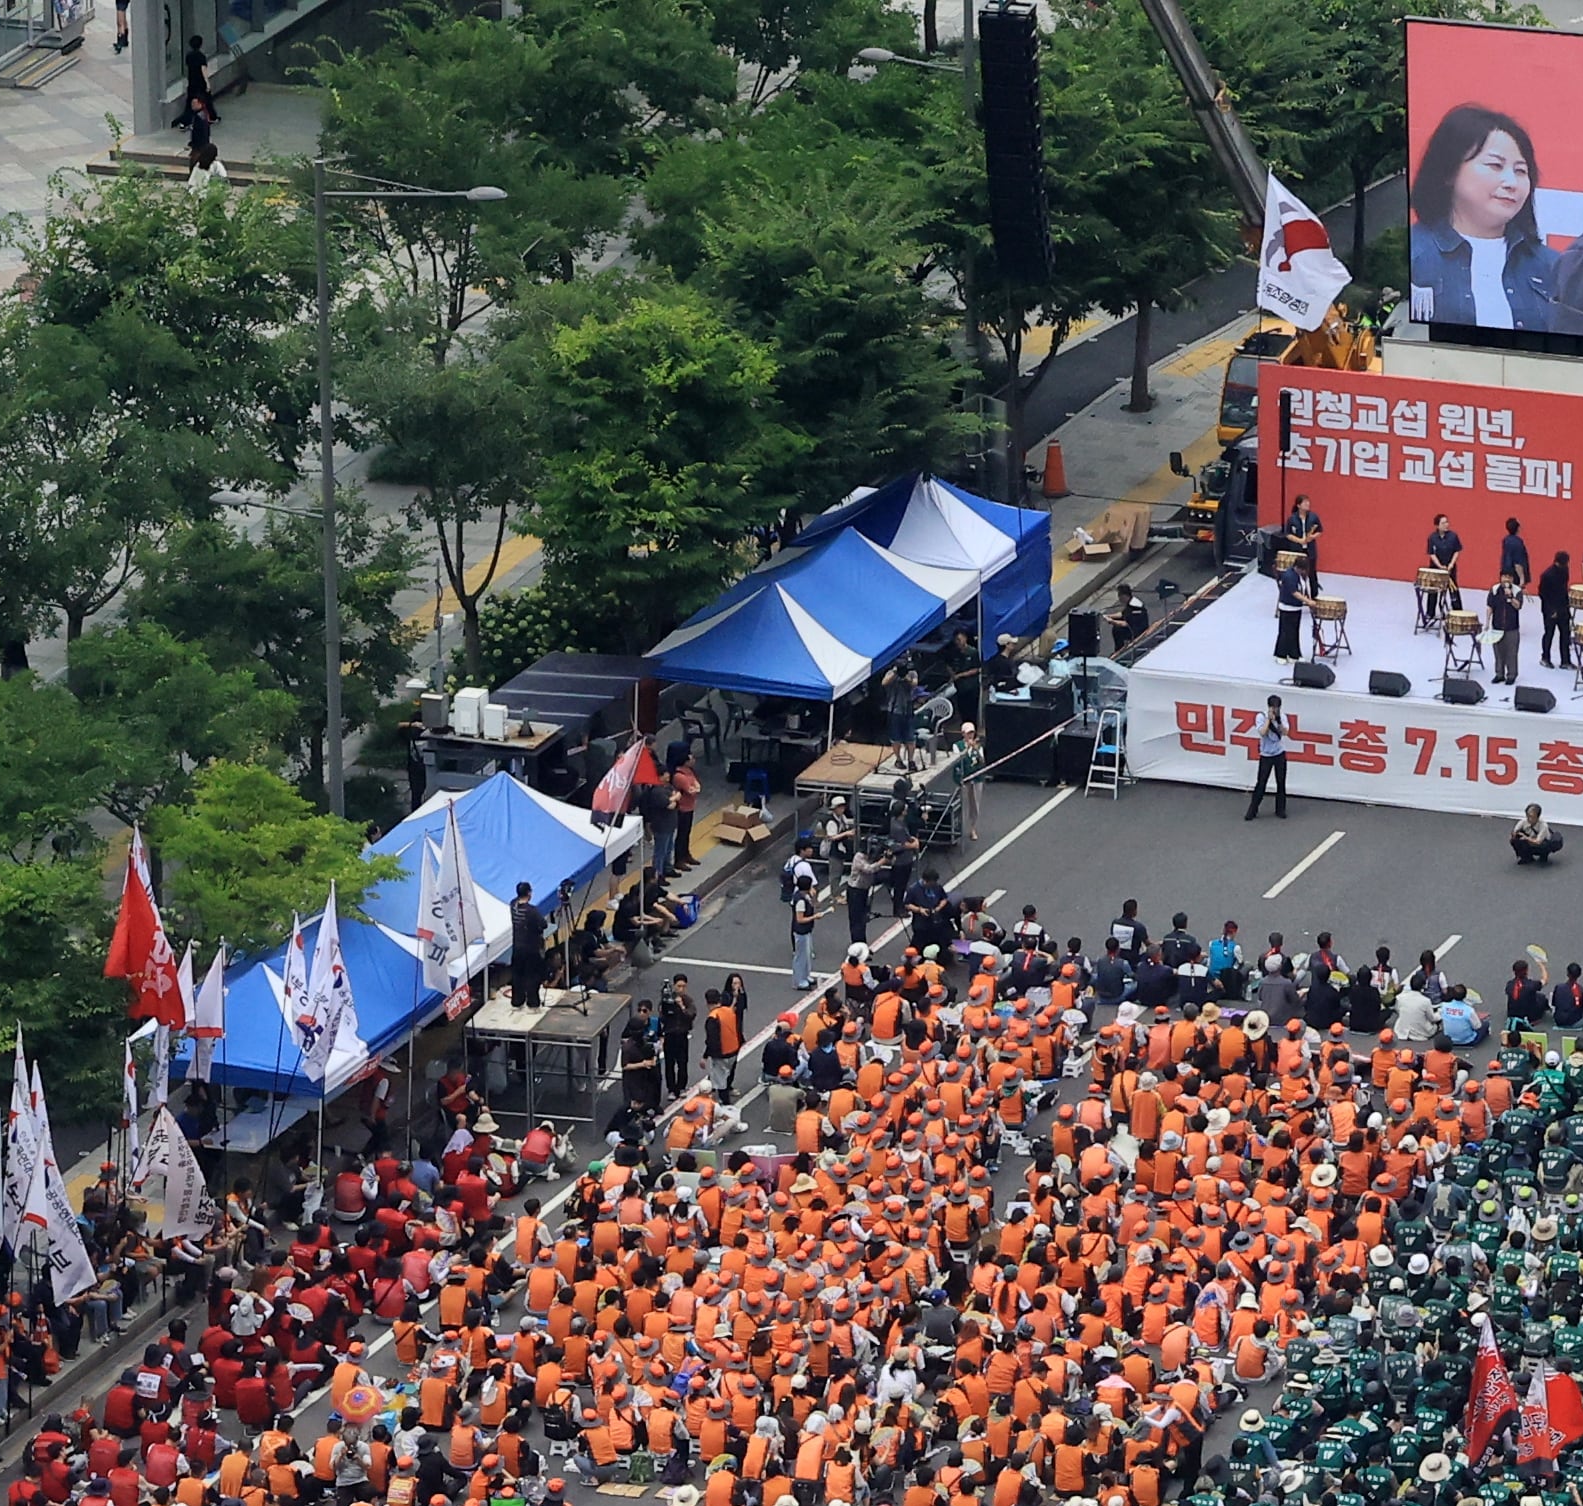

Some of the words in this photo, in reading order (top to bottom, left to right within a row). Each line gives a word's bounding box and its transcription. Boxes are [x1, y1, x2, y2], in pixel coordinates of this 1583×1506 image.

[1277, 387, 1427, 439] 원청교섭
[1438, 403, 1527, 450] 원년,
[1276, 432, 1389, 480] 초기업
[1399, 446, 1474, 489] 교섭
[1485, 453, 1572, 500] 돌파!
[1175, 701, 1388, 775] 민주노총
[1404, 726, 1519, 787] 7.15
